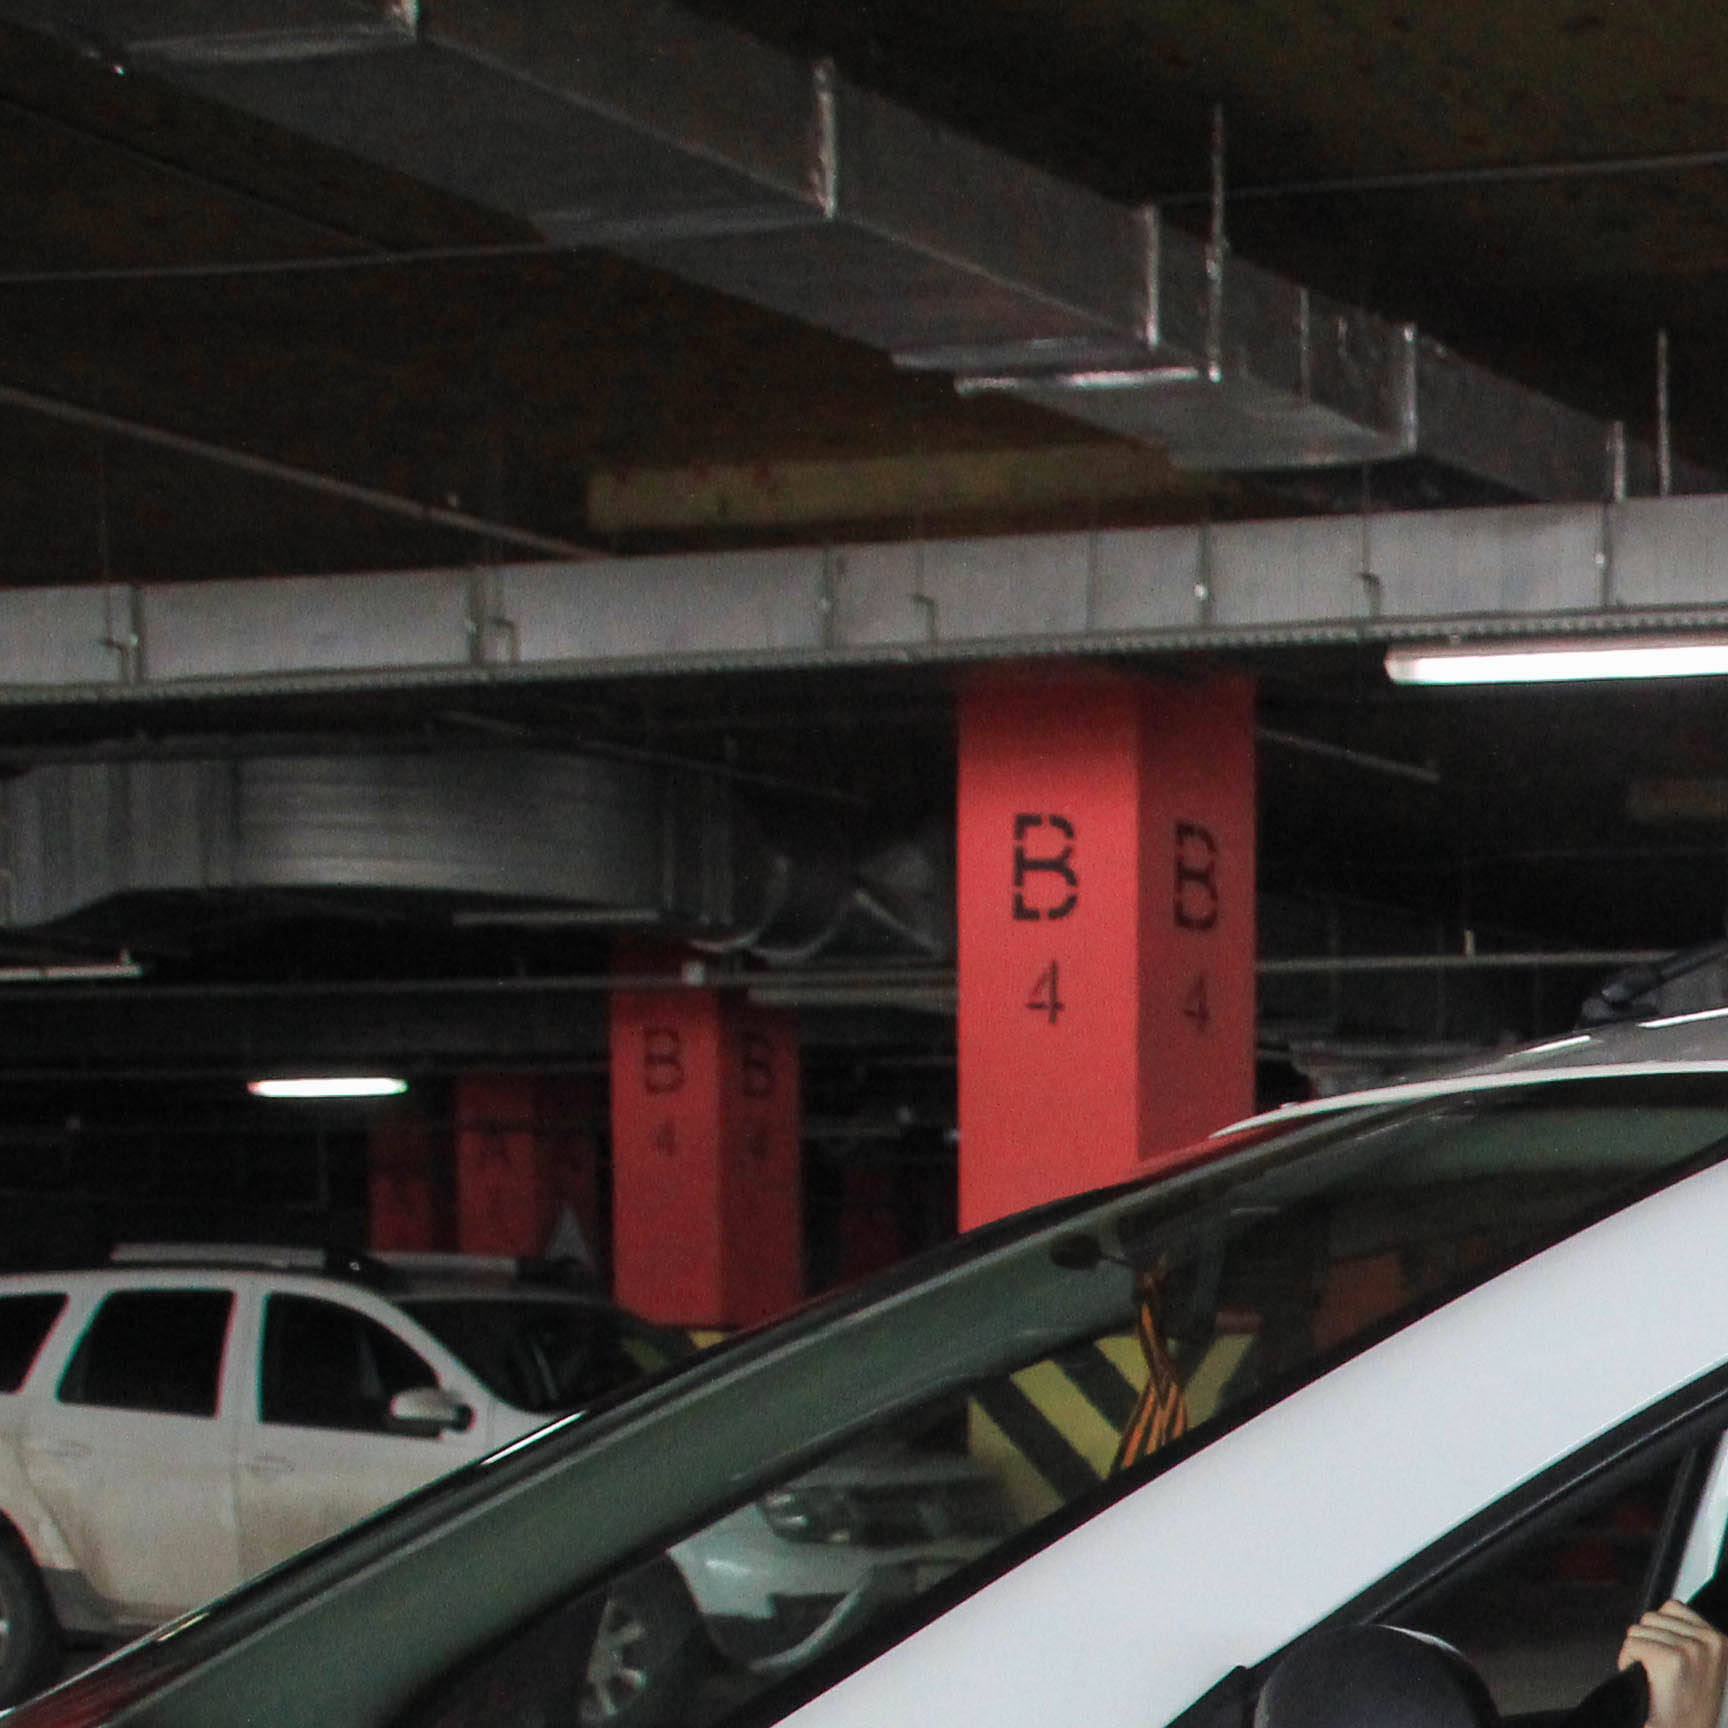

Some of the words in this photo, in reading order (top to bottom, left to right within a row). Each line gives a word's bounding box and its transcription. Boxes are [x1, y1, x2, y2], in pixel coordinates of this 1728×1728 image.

[1012, 813, 1079, 921] B
[1174, 821, 1219, 931] B
[1026, 960, 1065, 1025] 4
